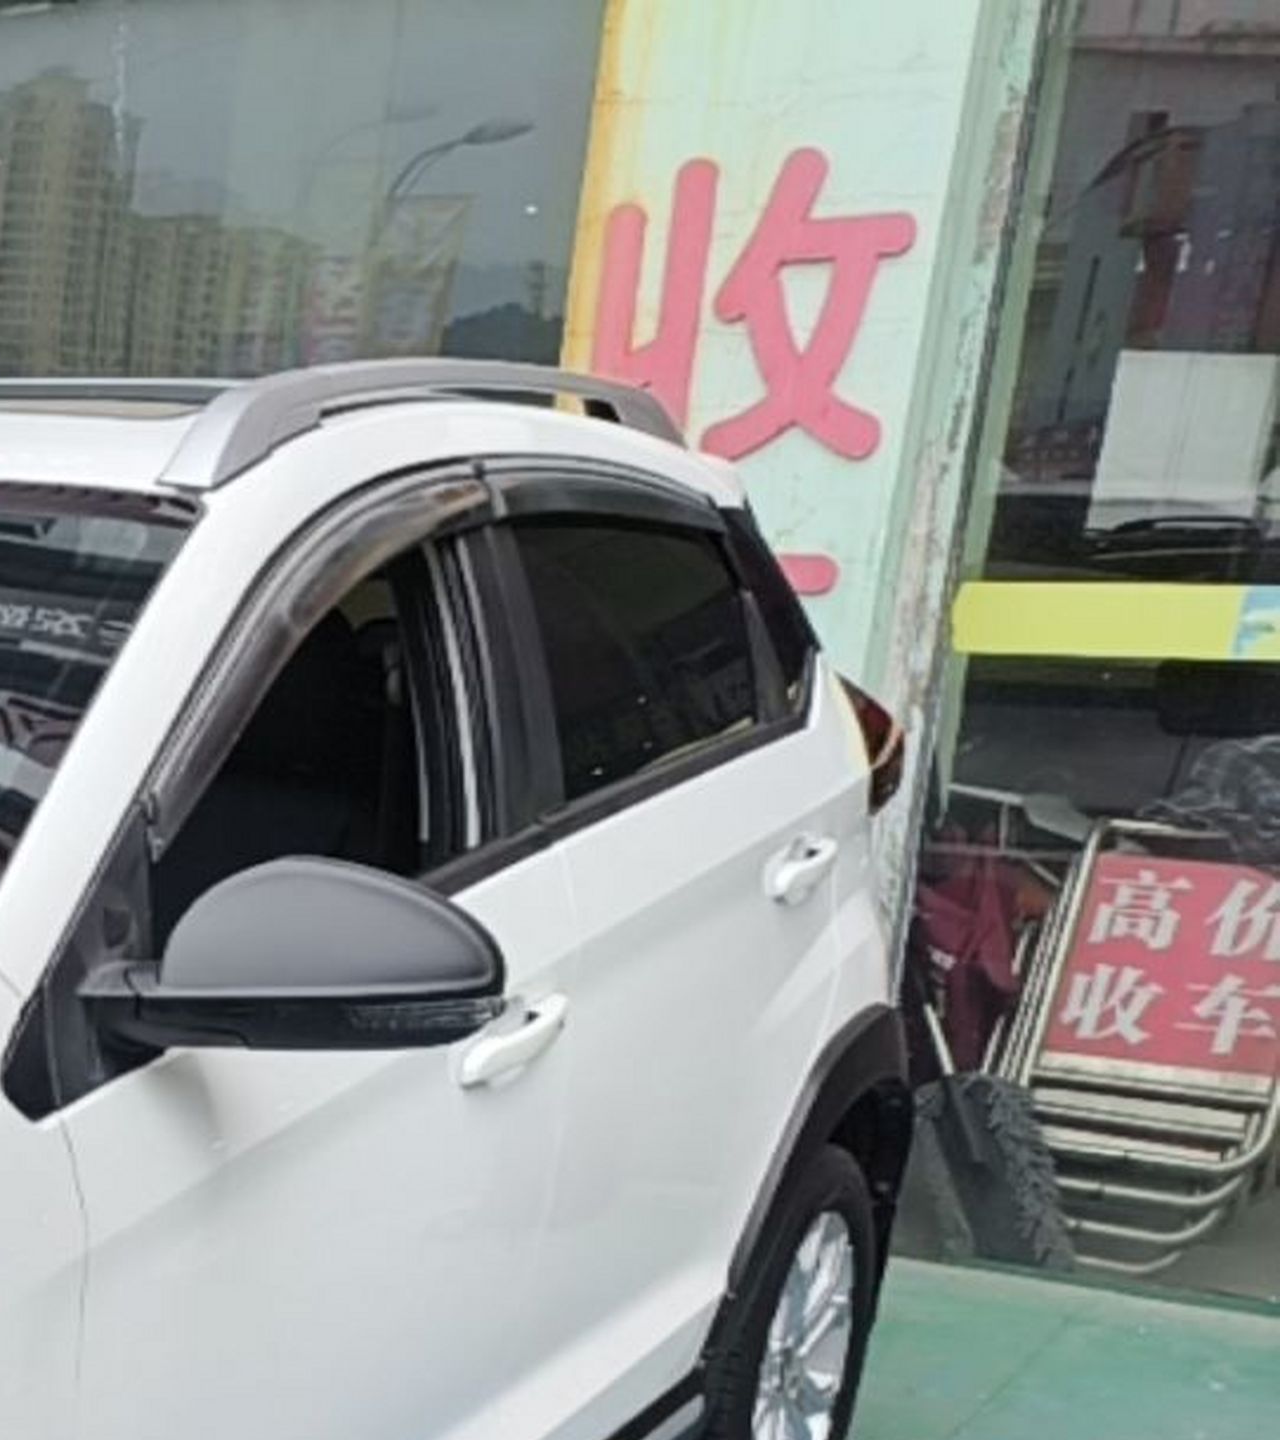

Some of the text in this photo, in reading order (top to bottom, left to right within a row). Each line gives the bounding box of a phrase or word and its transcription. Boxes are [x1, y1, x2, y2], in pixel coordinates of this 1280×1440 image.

[590, 145, 917, 597] 收
[1088, 868, 1280, 960] 高价
[1060, 963, 1280, 1055] 收车
